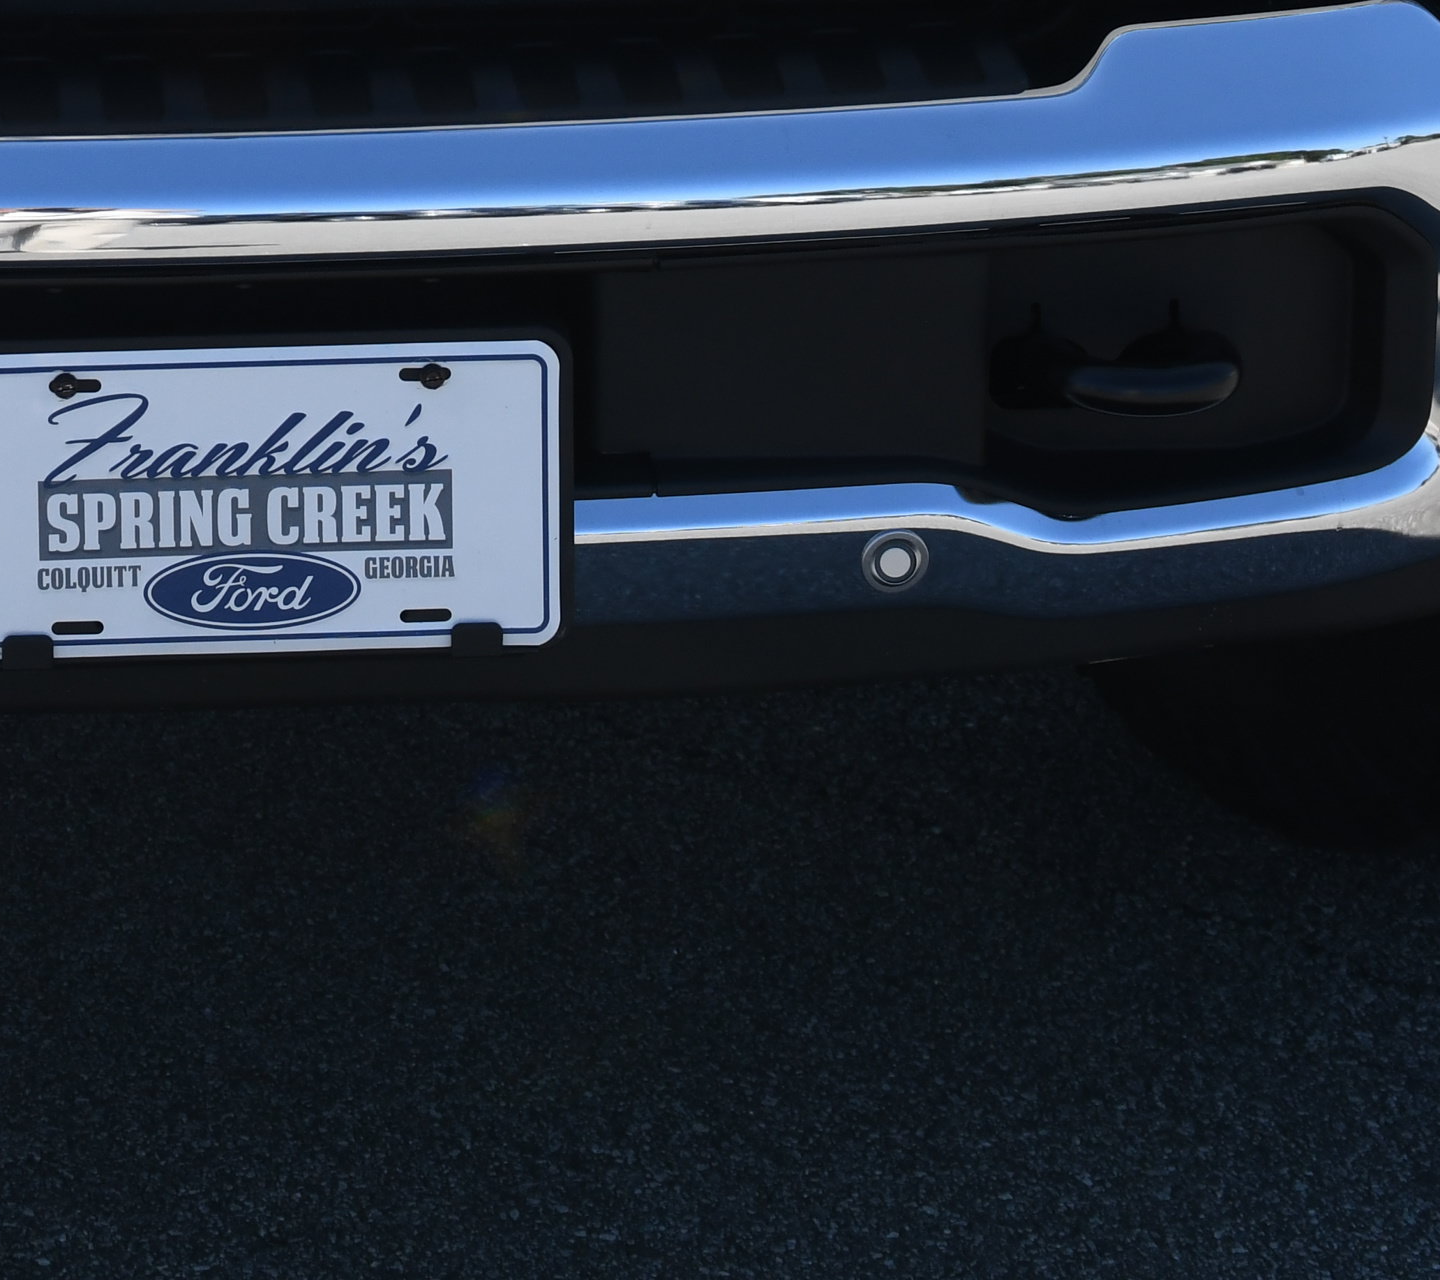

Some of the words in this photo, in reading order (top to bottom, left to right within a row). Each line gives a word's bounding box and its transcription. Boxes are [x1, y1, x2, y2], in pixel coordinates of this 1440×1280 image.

[43, 392, 450, 490] Franklin's
[46, 486, 254, 553] SPRING
[266, 481, 448, 547] CREEK
[37, 563, 142, 593] COLQUITT
[190, 562, 313, 615] Ford
[363, 555, 456, 582] GEORGIA
